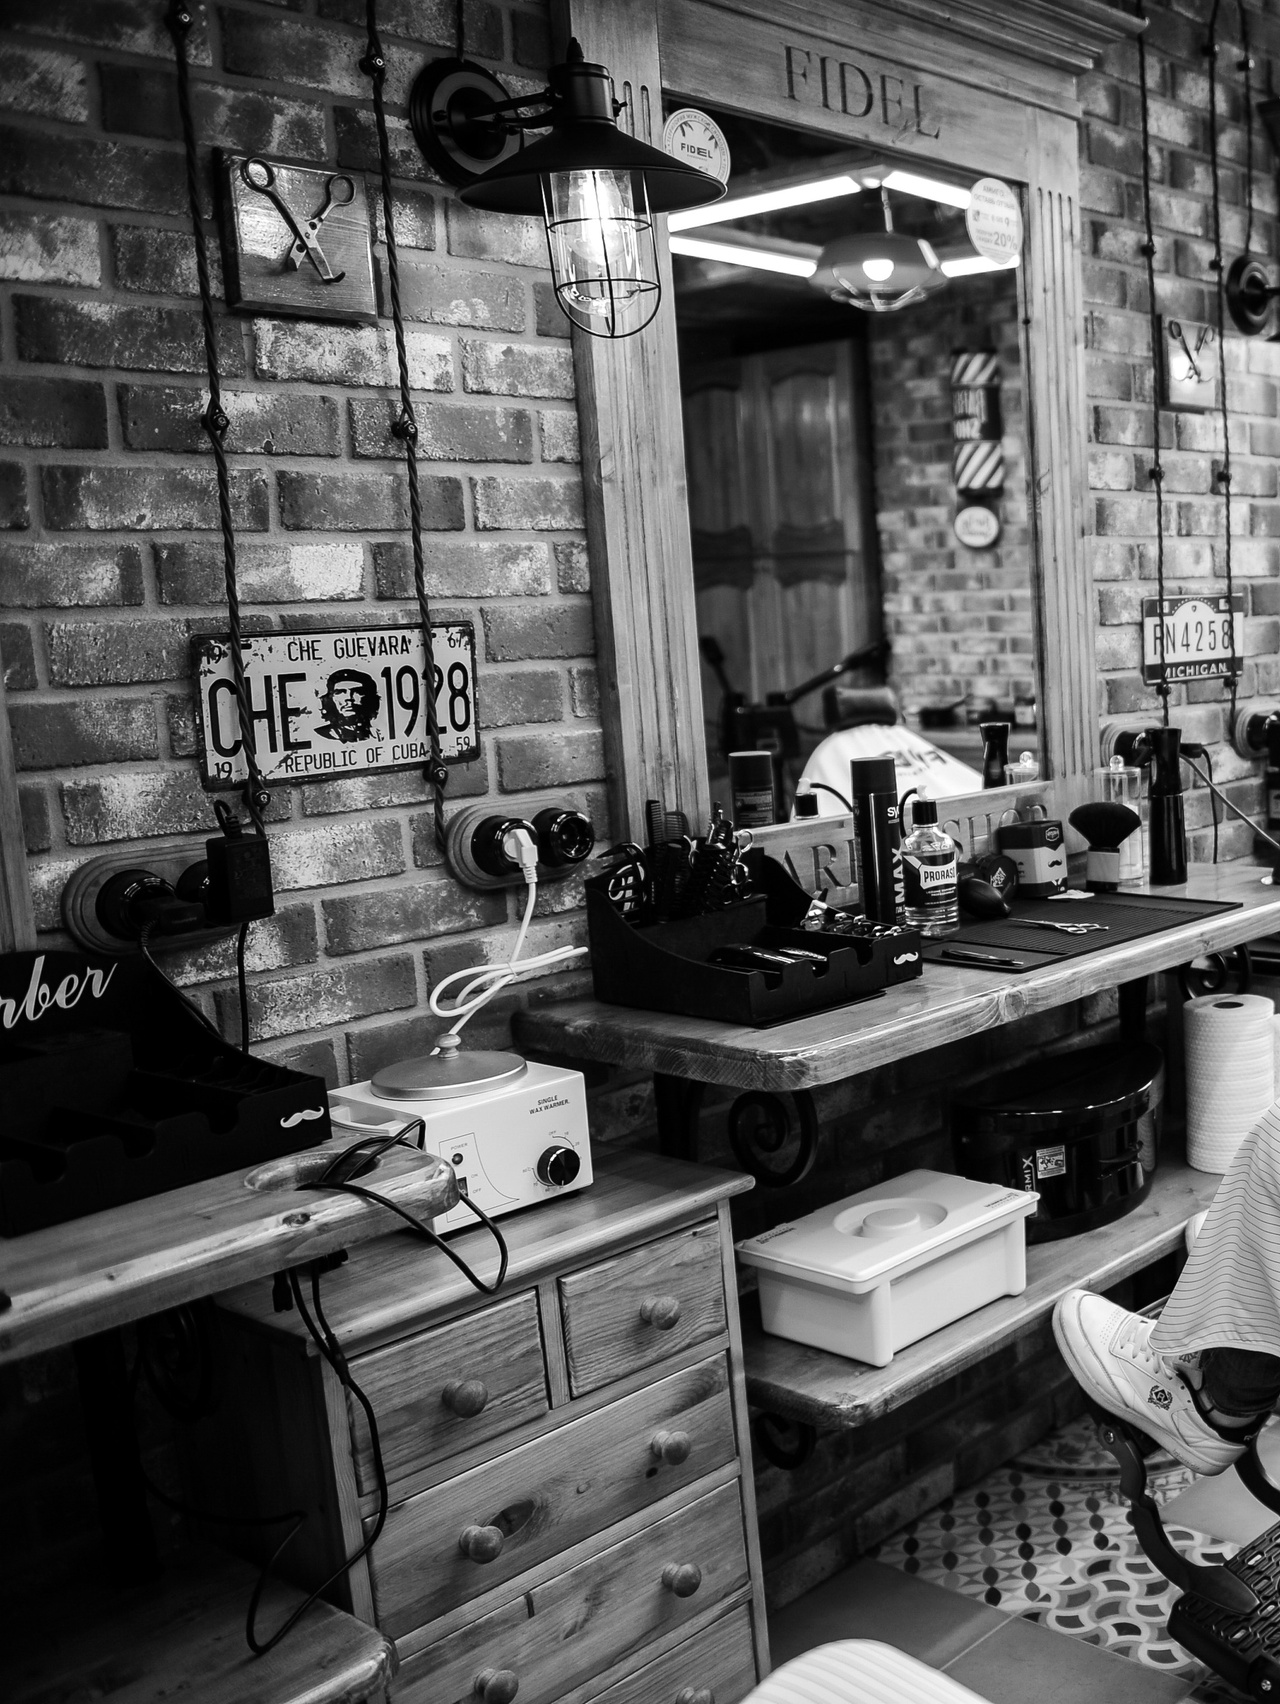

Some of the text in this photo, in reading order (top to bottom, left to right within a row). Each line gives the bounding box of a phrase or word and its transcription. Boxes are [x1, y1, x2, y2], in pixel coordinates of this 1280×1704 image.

[781, 44, 941, 139] FIDEL
[680, 142, 713, 159] FIDEL
[993, 231, 1018, 250] 20%
[287, 635, 410, 662] CHE GUEVARA
[447, 631, 464, 649] 67
[208, 661, 471, 758] CHE 1928
[456, 736, 471, 752] 59
[284, 742, 427, 774] REPUBLIC OF CUBA
[214, 761, 233, 779] 19
[537, 1095, 558, 1106] SINGLE
[529, 1106, 543, 1115] WAX
